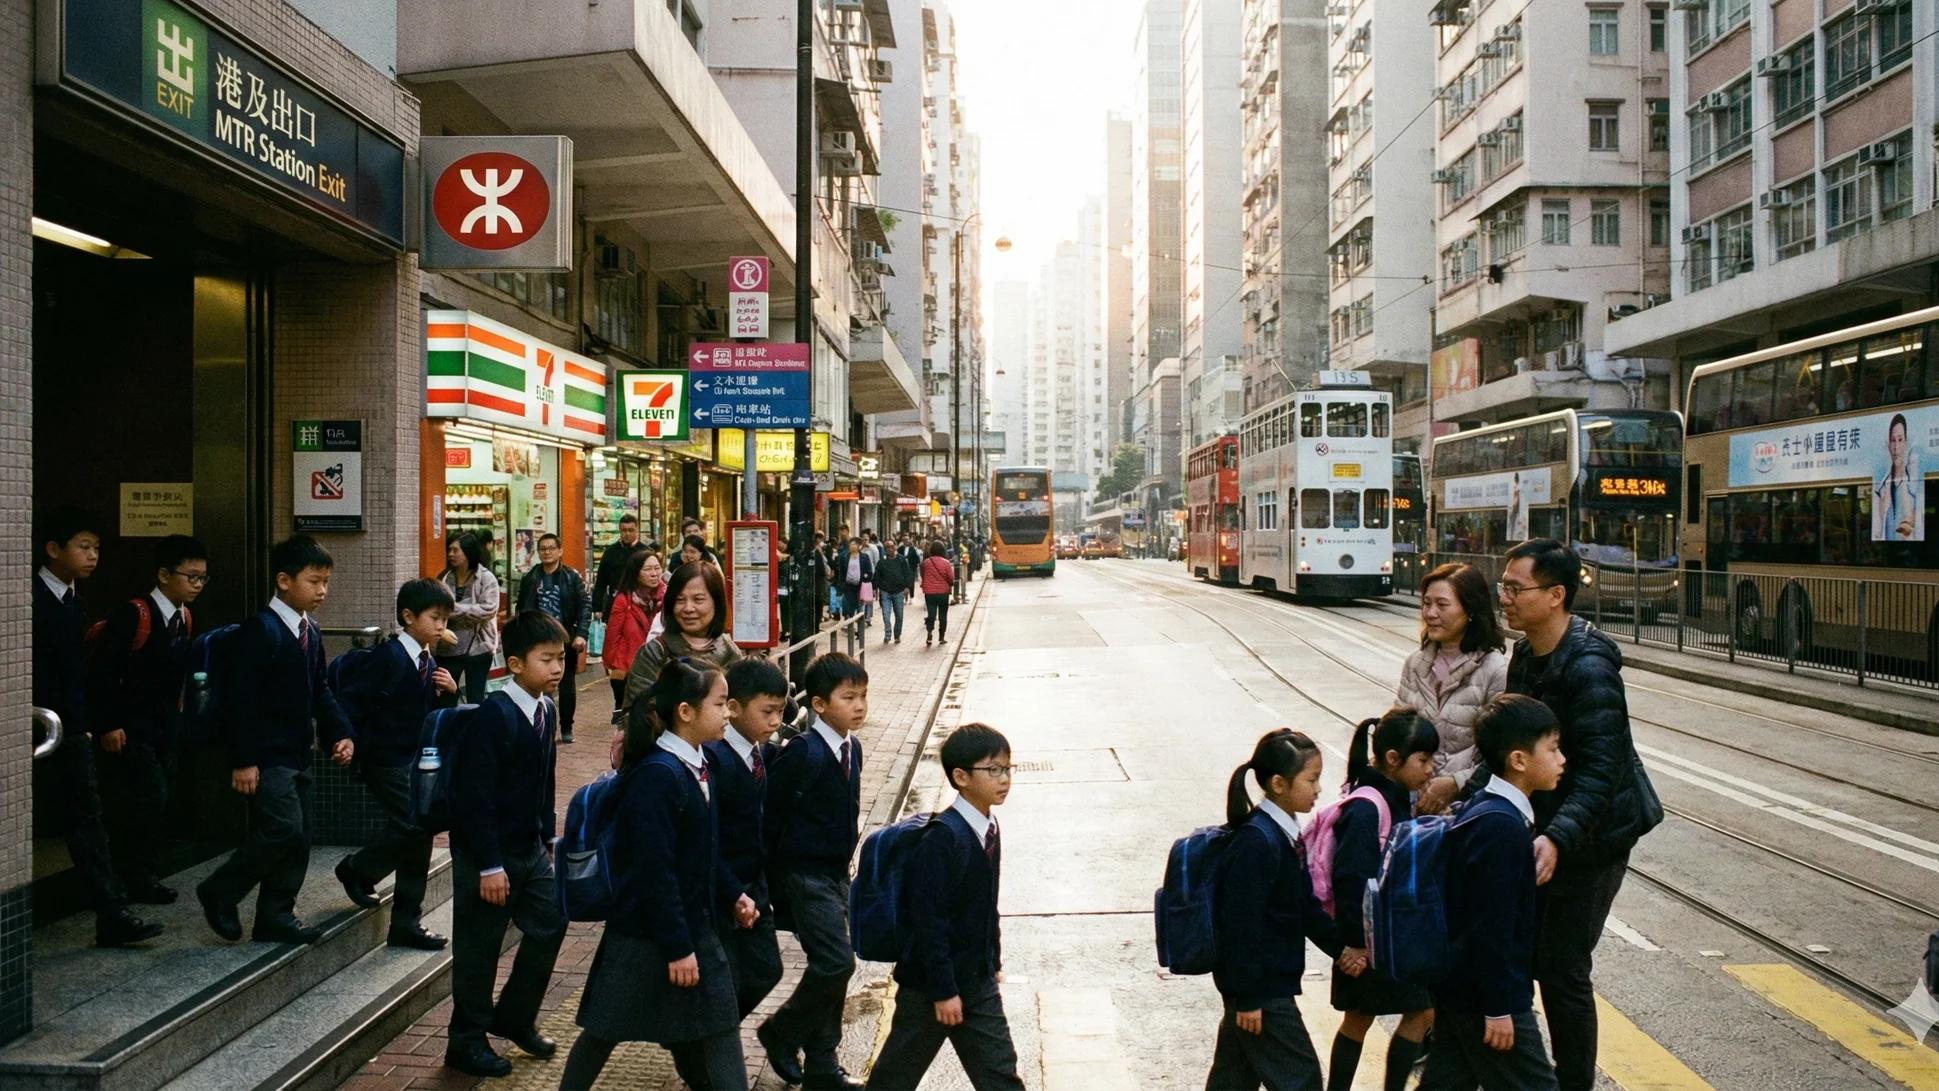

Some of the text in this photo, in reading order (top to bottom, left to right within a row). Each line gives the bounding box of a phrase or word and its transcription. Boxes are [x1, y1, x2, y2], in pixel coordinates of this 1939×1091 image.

[157, 18, 194, 95] 出
[157, 82, 193, 119] EXIT
[215, 52, 316, 147] 港及出口
[215, 109, 347, 203] MTR Station Exit
[633, 381, 673, 437] 7
